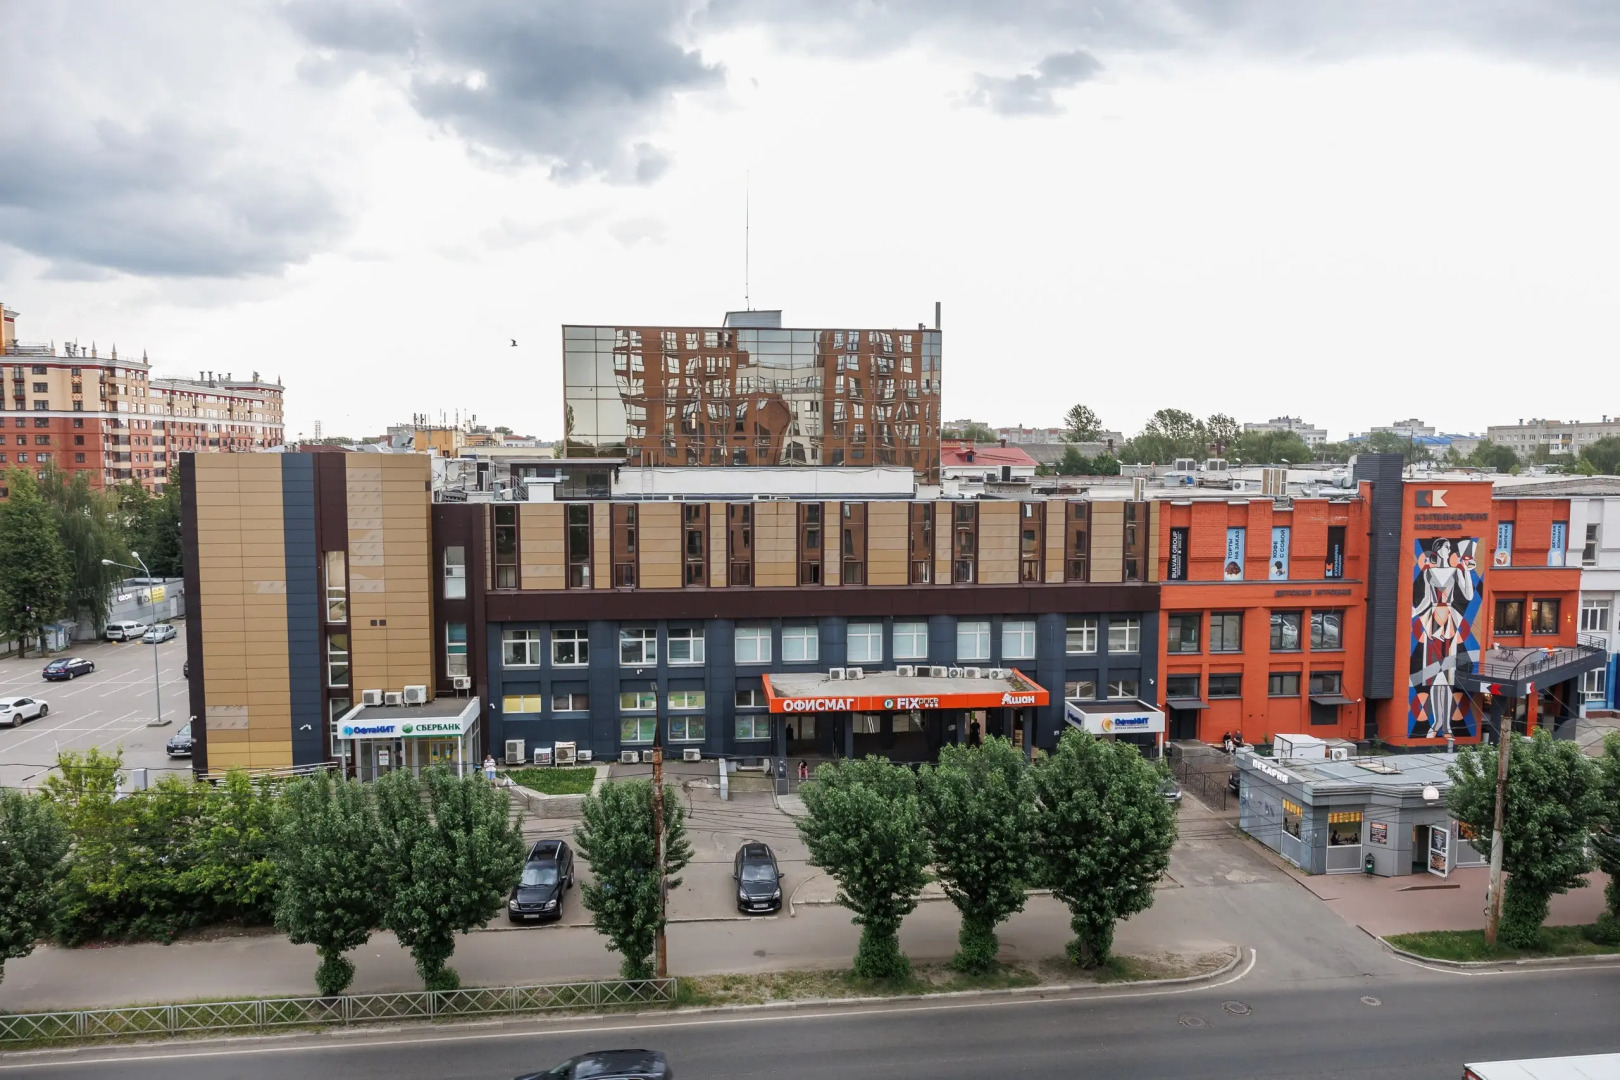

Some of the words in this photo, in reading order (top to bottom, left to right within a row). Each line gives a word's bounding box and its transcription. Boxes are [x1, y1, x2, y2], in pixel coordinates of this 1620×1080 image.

[118, 593, 133, 602] OZON
[783, 698, 855, 712] ОФИСМАГ
[897, 697, 919, 709] FIX
[918, 697, 939, 705] price
[1001, 693, 1035, 705] Ашан
[354, 725, 395, 735] ОфтаКИТ
[416, 723, 461, 732] СБЕРБАНК
[1252, 758, 1289, 784] ПЕКАРНЯ
